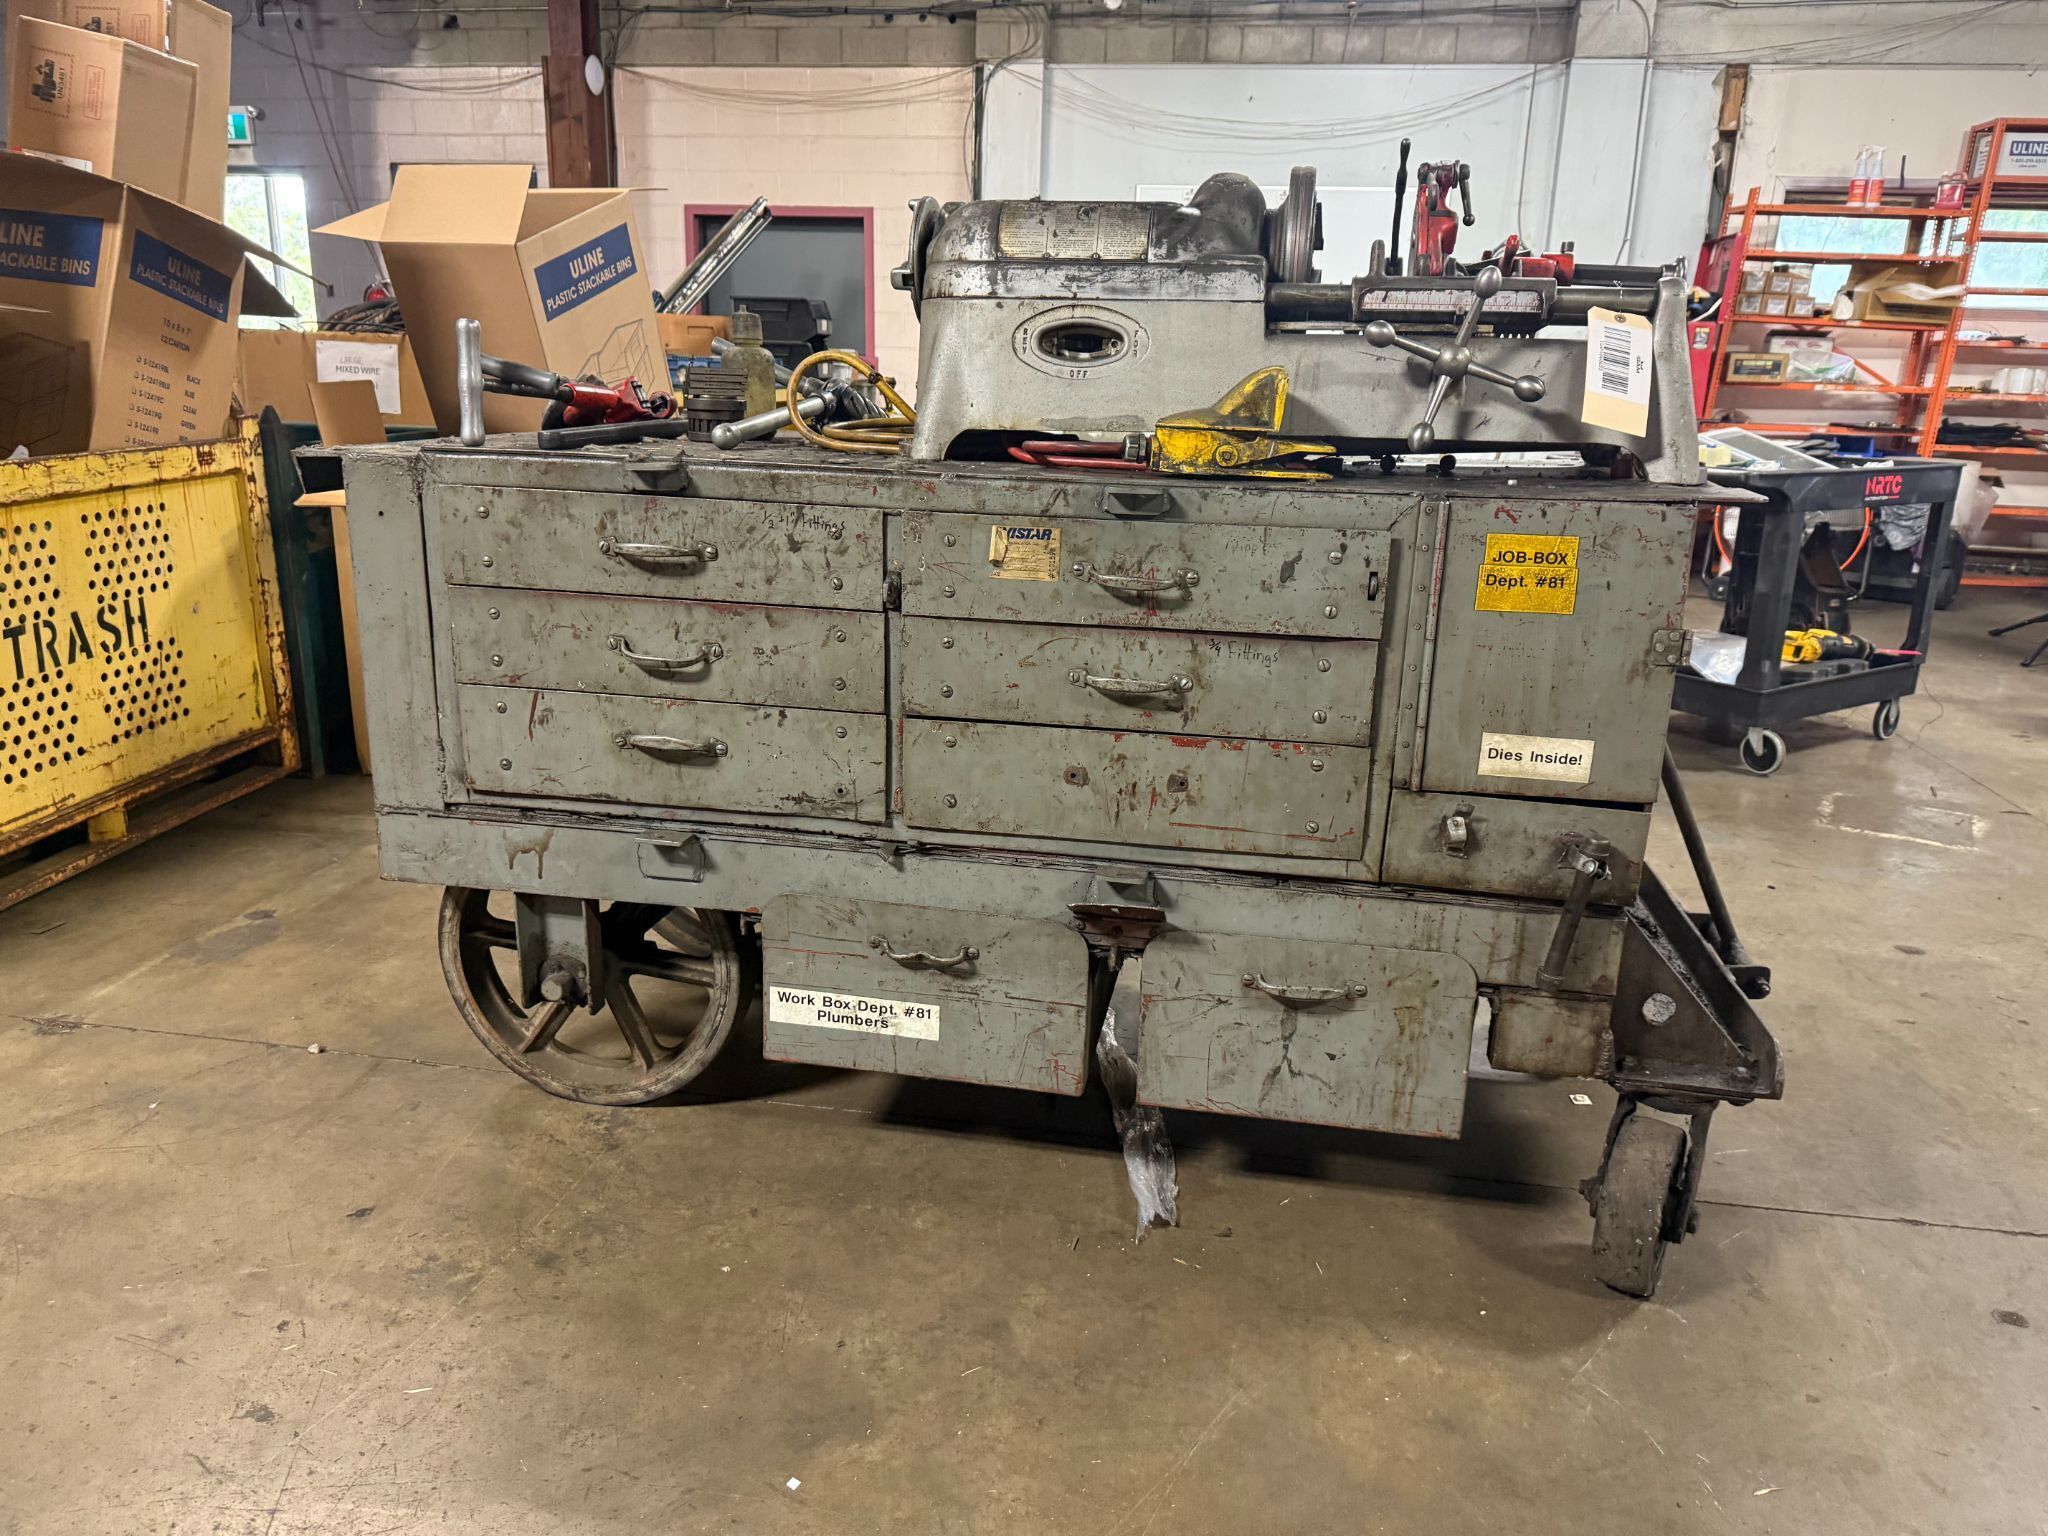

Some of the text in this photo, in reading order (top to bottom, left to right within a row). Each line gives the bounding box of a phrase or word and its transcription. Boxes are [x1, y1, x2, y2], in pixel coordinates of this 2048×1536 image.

[2012, 142, 2048, 155] ULINE
[61, 257, 91, 276] BINS
[168, 256, 201, 286] ULINE
[569, 246, 605, 279] ULINE
[137, 264, 168, 287] PLASTIC
[546, 255, 632, 312] PLASTIC STACKABLE BINS
[336, 365, 381, 376] MIXED WIRE
[1069, 370, 1089, 379] OFF
[182, 404, 197, 415] CLEAR
[1865, 475, 1903, 496] NRTC
[1493, 551, 1569, 565] JOB-BOX
[1486, 574, 1565, 590] Dept. #81
[3, 597, 149, 680] TRASH
[1228, 641, 1279, 668] Fittings
[1488, 748, 1583, 766] Dies Inside!
[778, 991, 932, 1020] Work Box Dept. #81
[817, 1010, 889, 1029] Plumbers
